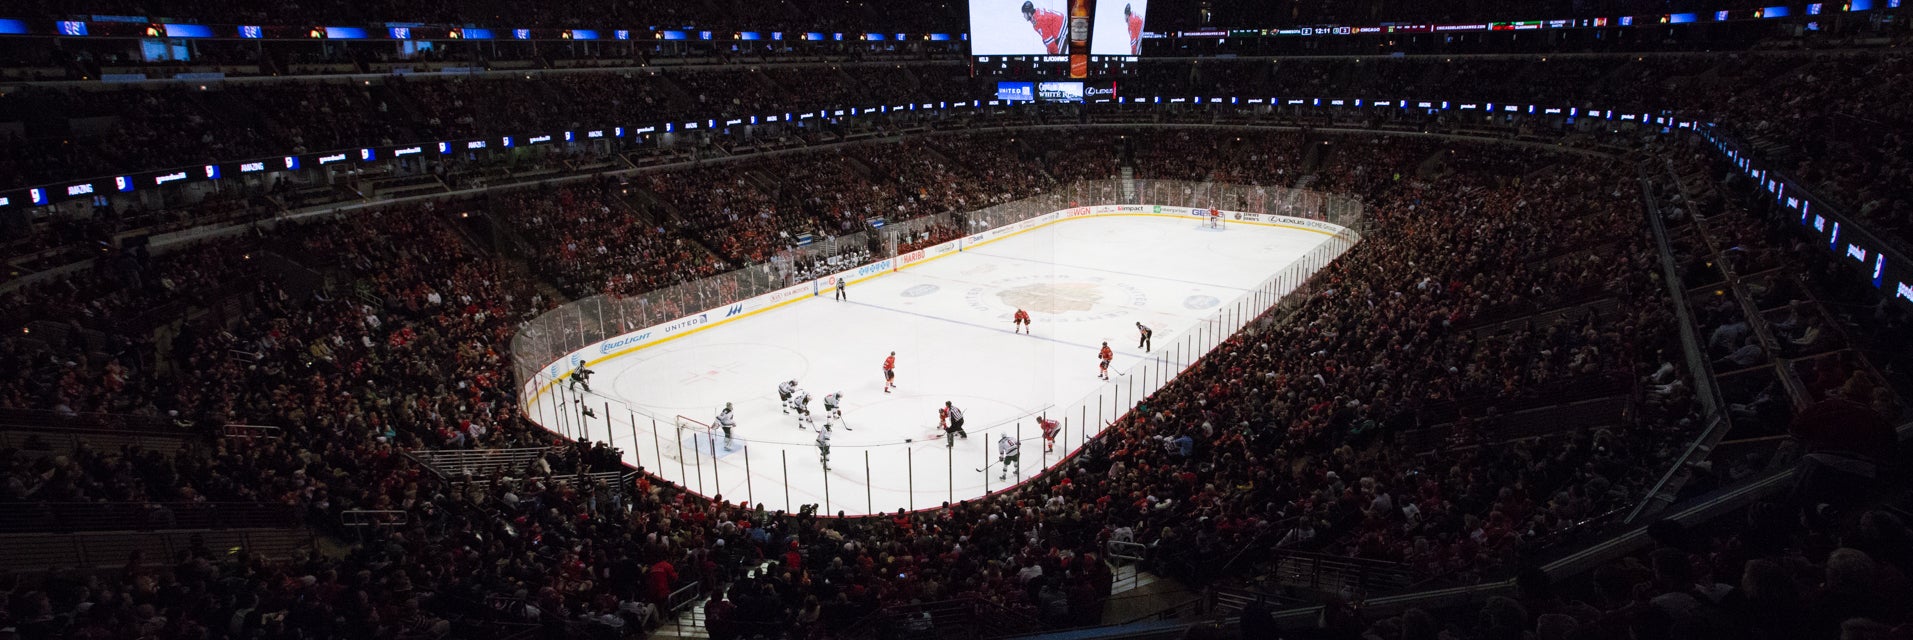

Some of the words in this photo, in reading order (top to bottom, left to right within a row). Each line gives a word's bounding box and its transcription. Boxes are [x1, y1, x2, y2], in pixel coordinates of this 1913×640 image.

[1073, 207, 1091, 217] WGN
[1278, 218, 1305, 226] LEXUS
[903, 250, 926, 264] HARIBO
[665, 318, 698, 333] UNITED
[602, 340, 624, 351] BUD
[624, 332, 652, 345] LIGHT
